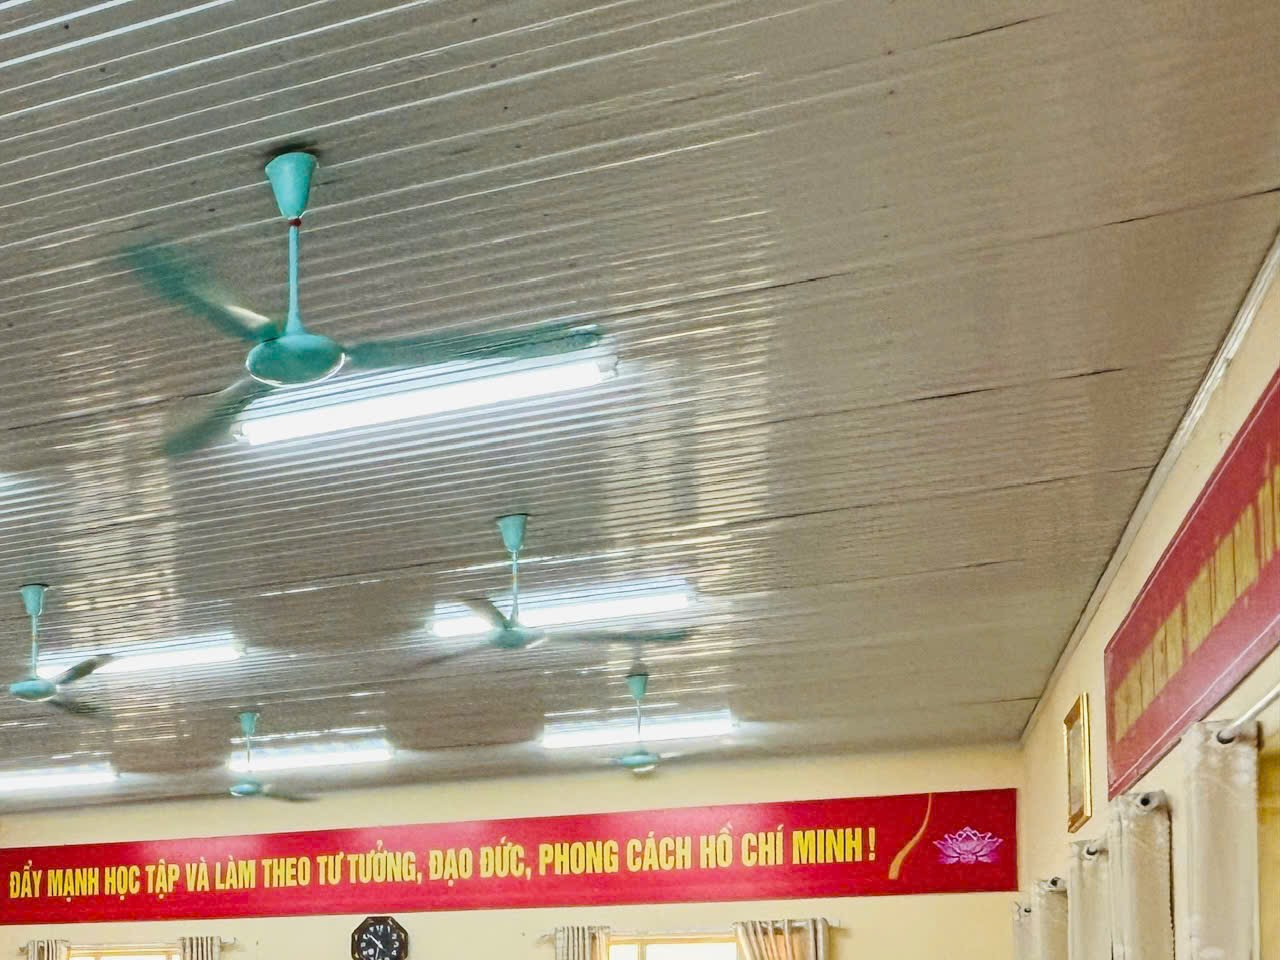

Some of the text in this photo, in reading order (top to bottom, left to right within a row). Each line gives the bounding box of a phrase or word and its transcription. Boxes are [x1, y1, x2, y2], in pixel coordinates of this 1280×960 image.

[10, 860, 41, 898] ĐẨY
[48, 865, 99, 902] MẠNH
[105, 865, 140, 900] HỌC
[145, 858, 180, 899] TẬP
[186, 855, 210, 891] VÀ
[216, 853, 256, 889] LÀM
[262, 856, 310, 887] THEO
[316, 850, 345, 885] TƯ
[347, 838, 423, 885] TƯỞNG,
[428, 846, 473, 887] ĐẠO
[479, 836, 532, 881] ĐỨC,
[539, 842, 618, 875] PHONG
[627, 831, 691, 872] CÁCH
[700, 822, 733, 869] HỒ
[741, 825, 784, 867] CHÍ
